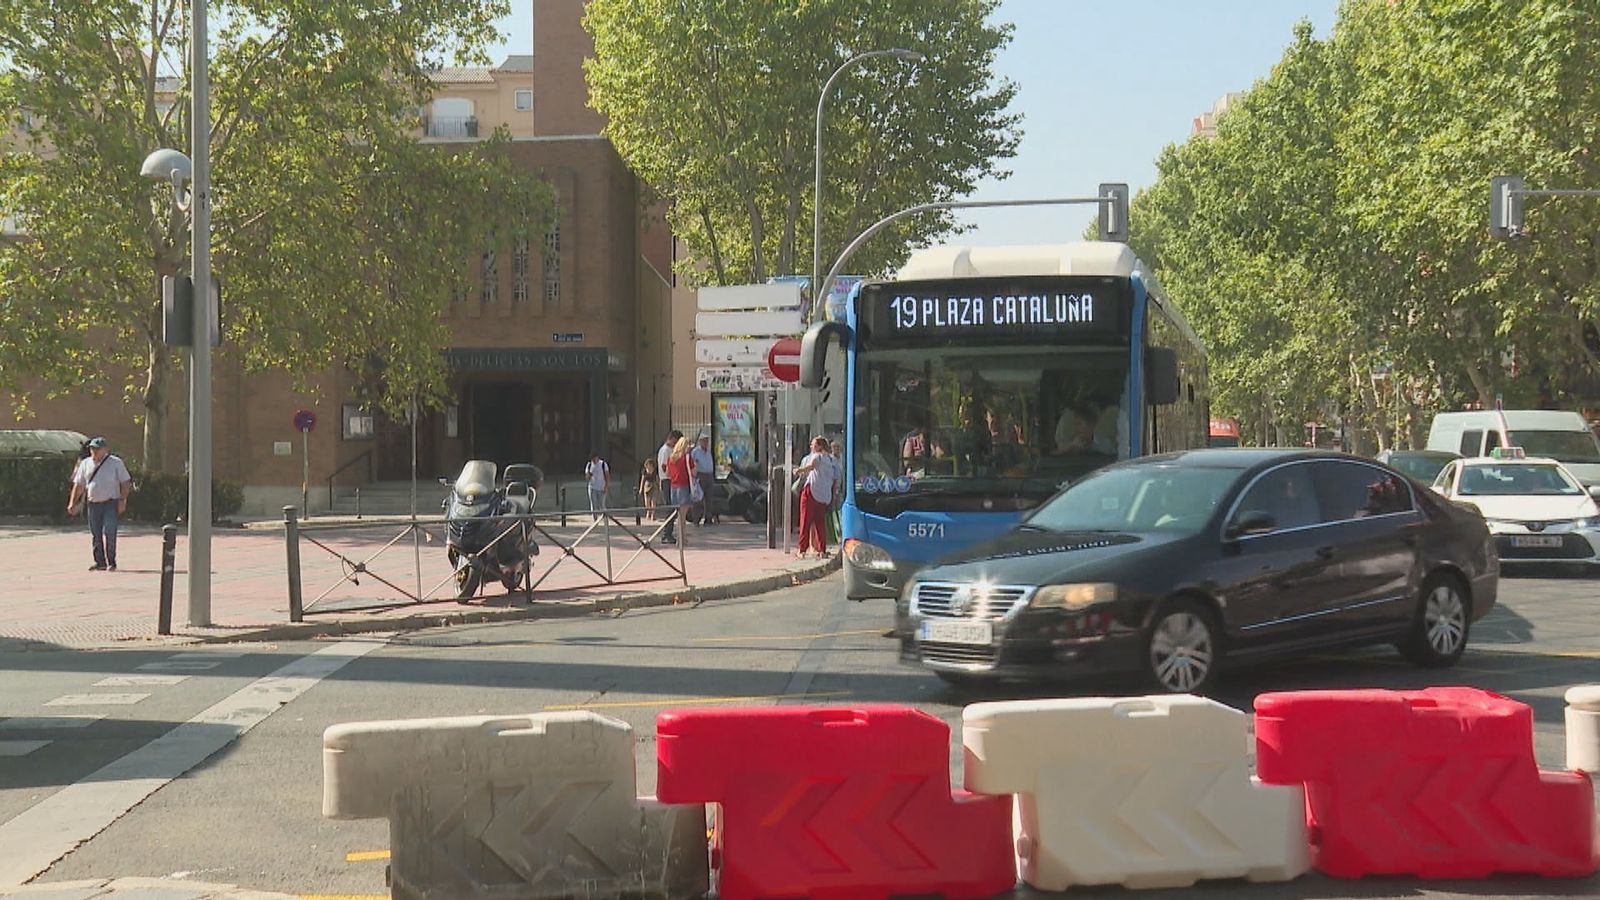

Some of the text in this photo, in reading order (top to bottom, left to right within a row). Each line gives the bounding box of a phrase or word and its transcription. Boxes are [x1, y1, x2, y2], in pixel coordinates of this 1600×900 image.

[890, 294, 1093, 328] 19 PLAZA CATALUÑA
[575, 353, 600, 368] LOS
[908, 523, 945, 539] 5571
